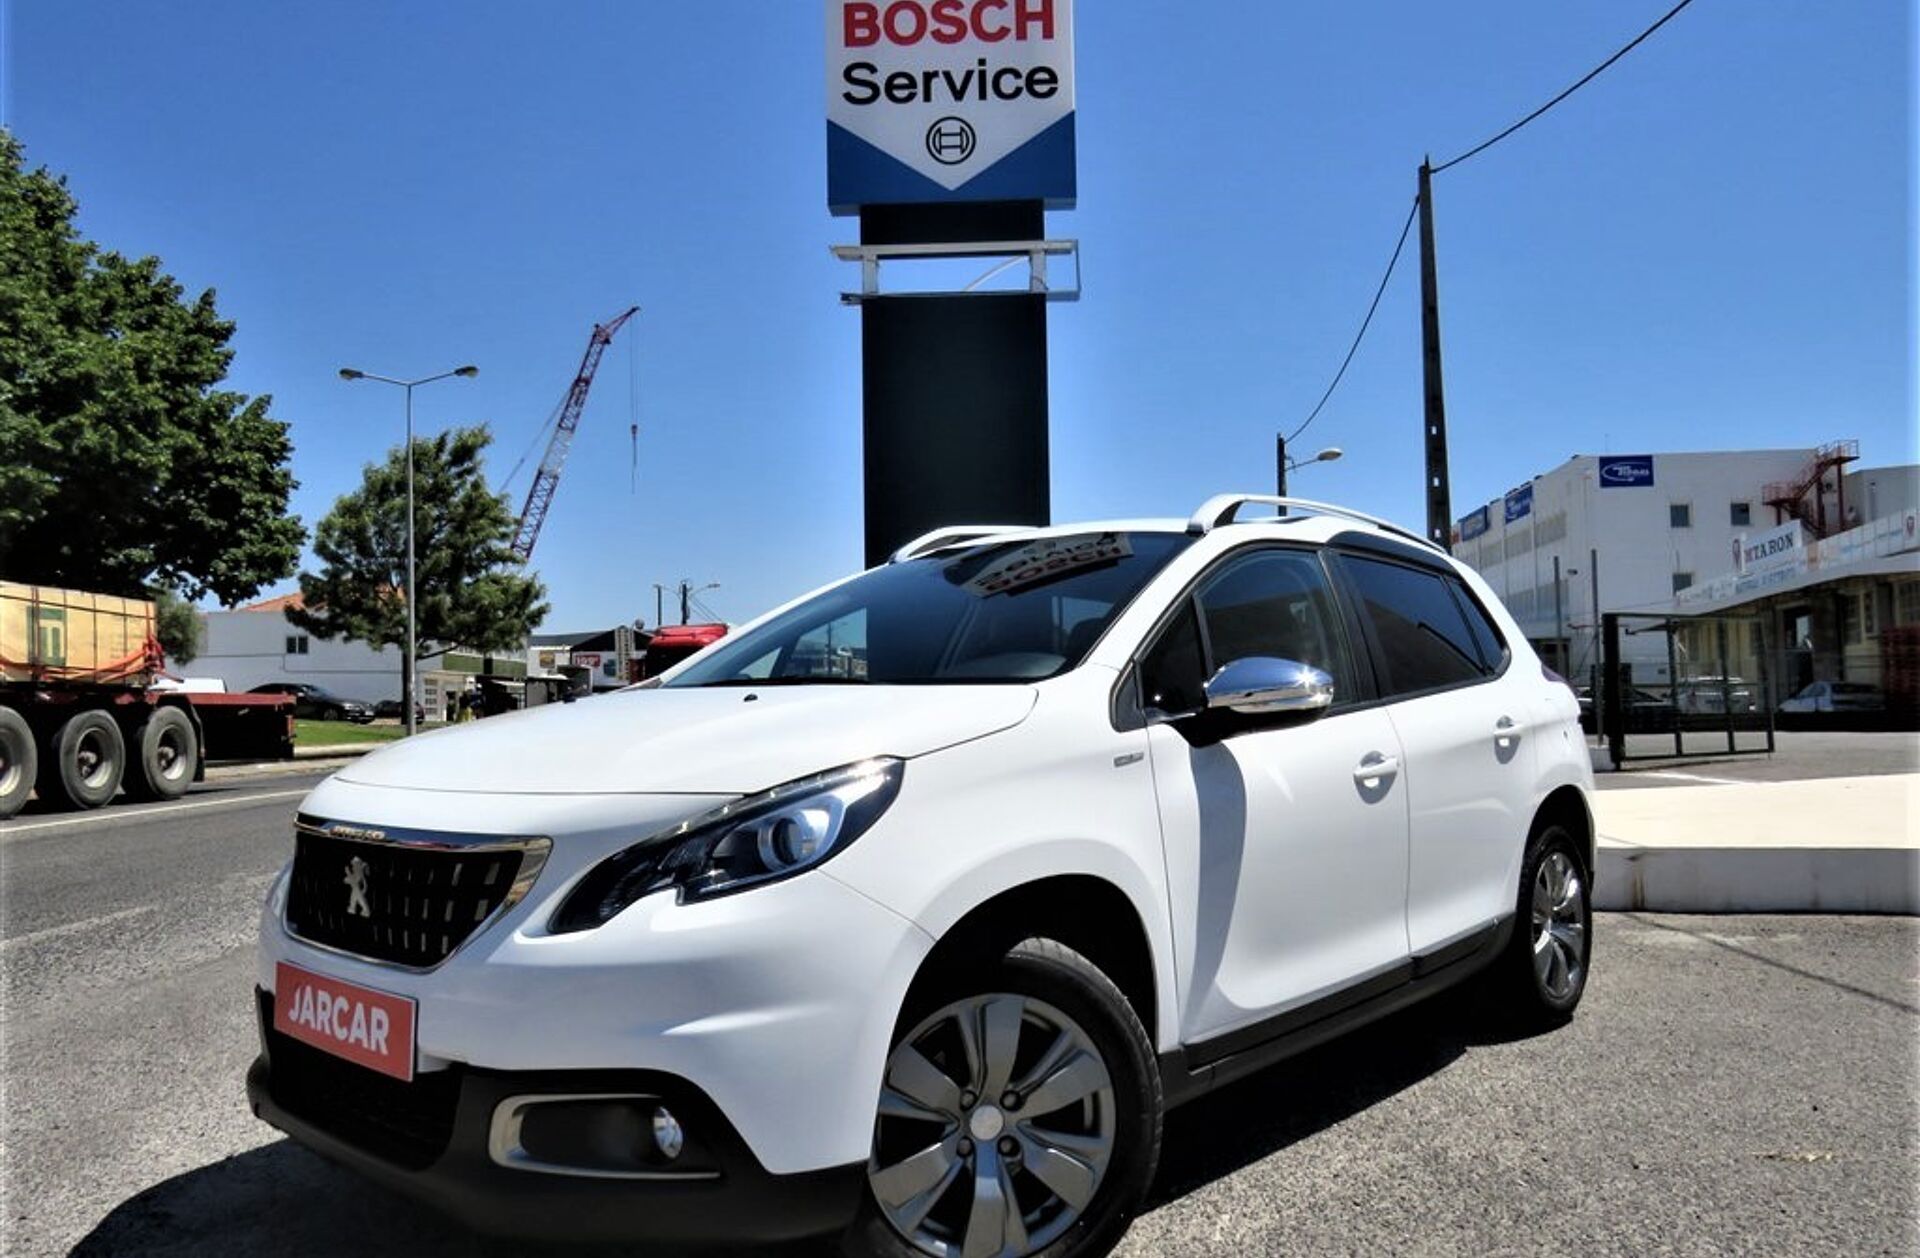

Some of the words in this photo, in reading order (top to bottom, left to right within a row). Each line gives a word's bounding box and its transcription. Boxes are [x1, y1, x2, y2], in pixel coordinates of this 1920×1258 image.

[843, 0, 1055, 48] BOSCH
[842, 58, 1059, 105] Service
[288, 985, 390, 1056] JARCAR
